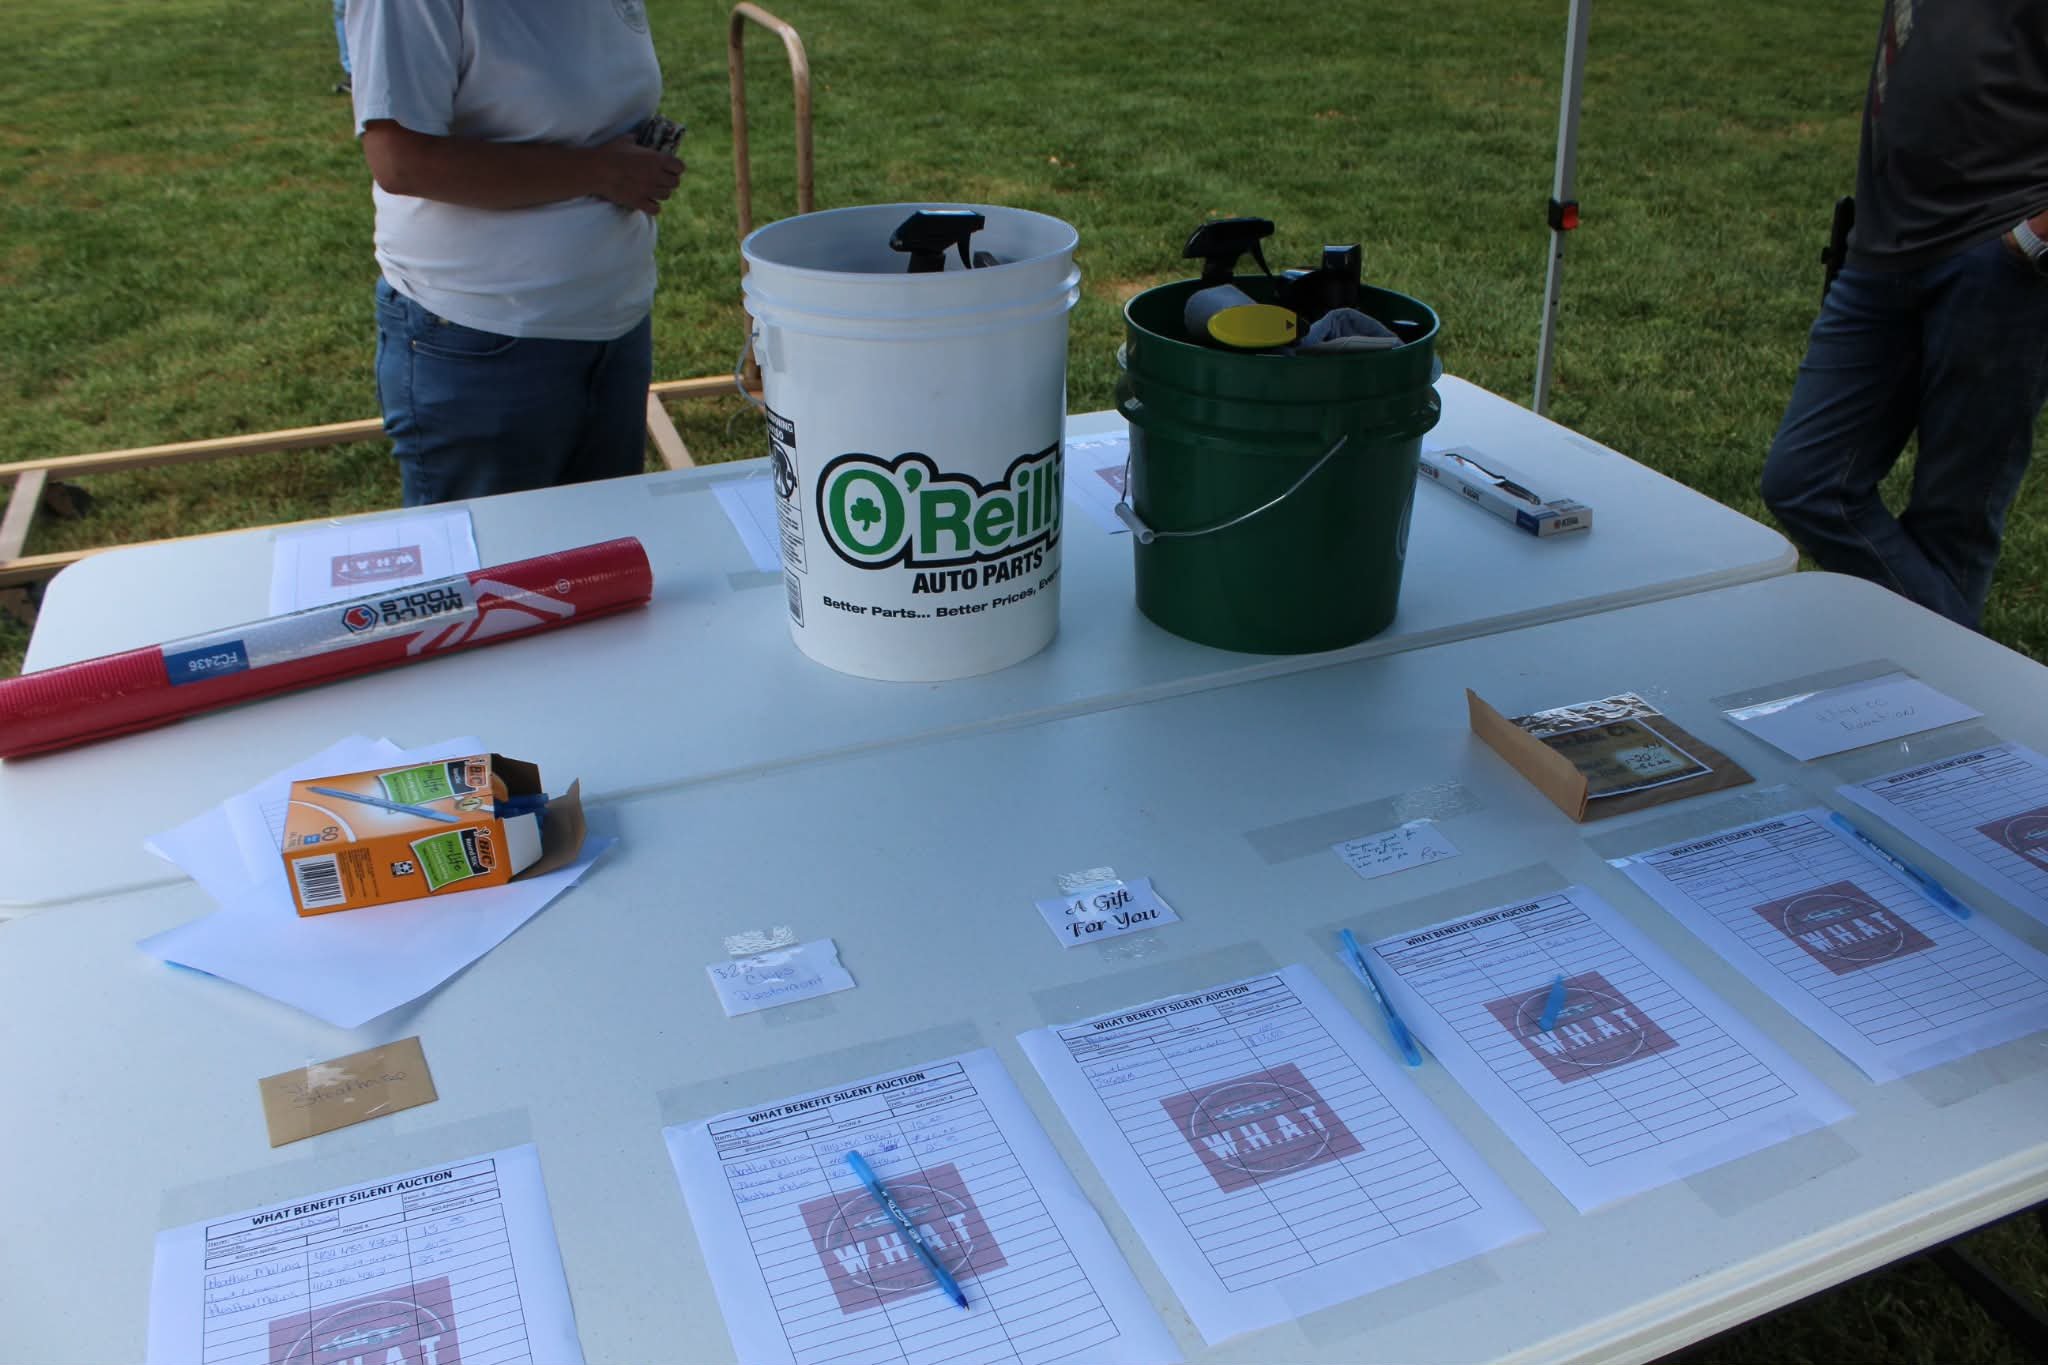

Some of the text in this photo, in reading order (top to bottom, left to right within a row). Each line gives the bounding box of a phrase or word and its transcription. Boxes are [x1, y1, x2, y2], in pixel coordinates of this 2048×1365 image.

[912, 549, 1043, 594] AUTO PARTS
[379, 587, 461, 611] TOOLS
[383, 597, 464, 625] MATCO
[823, 595, 867, 615] Better
[871, 606, 931, 619] Parts...
[936, 599, 988, 618] Better
[992, 584, 1037, 608] Prices,
[189, 652, 238, 671] FC2436
[322, 826, 339, 842] 60
[1065, 889, 1134, 916] A Gift
[1065, 907, 1161, 937] For You
[1405, 903, 1540, 946] WHAT BENEFIT SILENT AUCTION
[1800, 911, 1898, 952] W.H.A.T
[1094, 986, 1249, 1030] WHAT BENEFIT SILENT AUCTION
[1527, 1007, 1640, 1056] W.H.A.T
[748, 1108, 782, 1123] WHAT
[785, 1096, 832, 1115] BENEFIT
[834, 1085, 872, 1102] SILENT
[876, 1072, 925, 1091] AUCTION
[1201, 1106, 1326, 1161] W.H.A.T
[252, 1209, 290, 1225] WHAT
[294, 1195, 347, 1216] BENEFIT
[350, 1185, 393, 1201] SILENT
[397, 1170, 452, 1190] AUCTION
